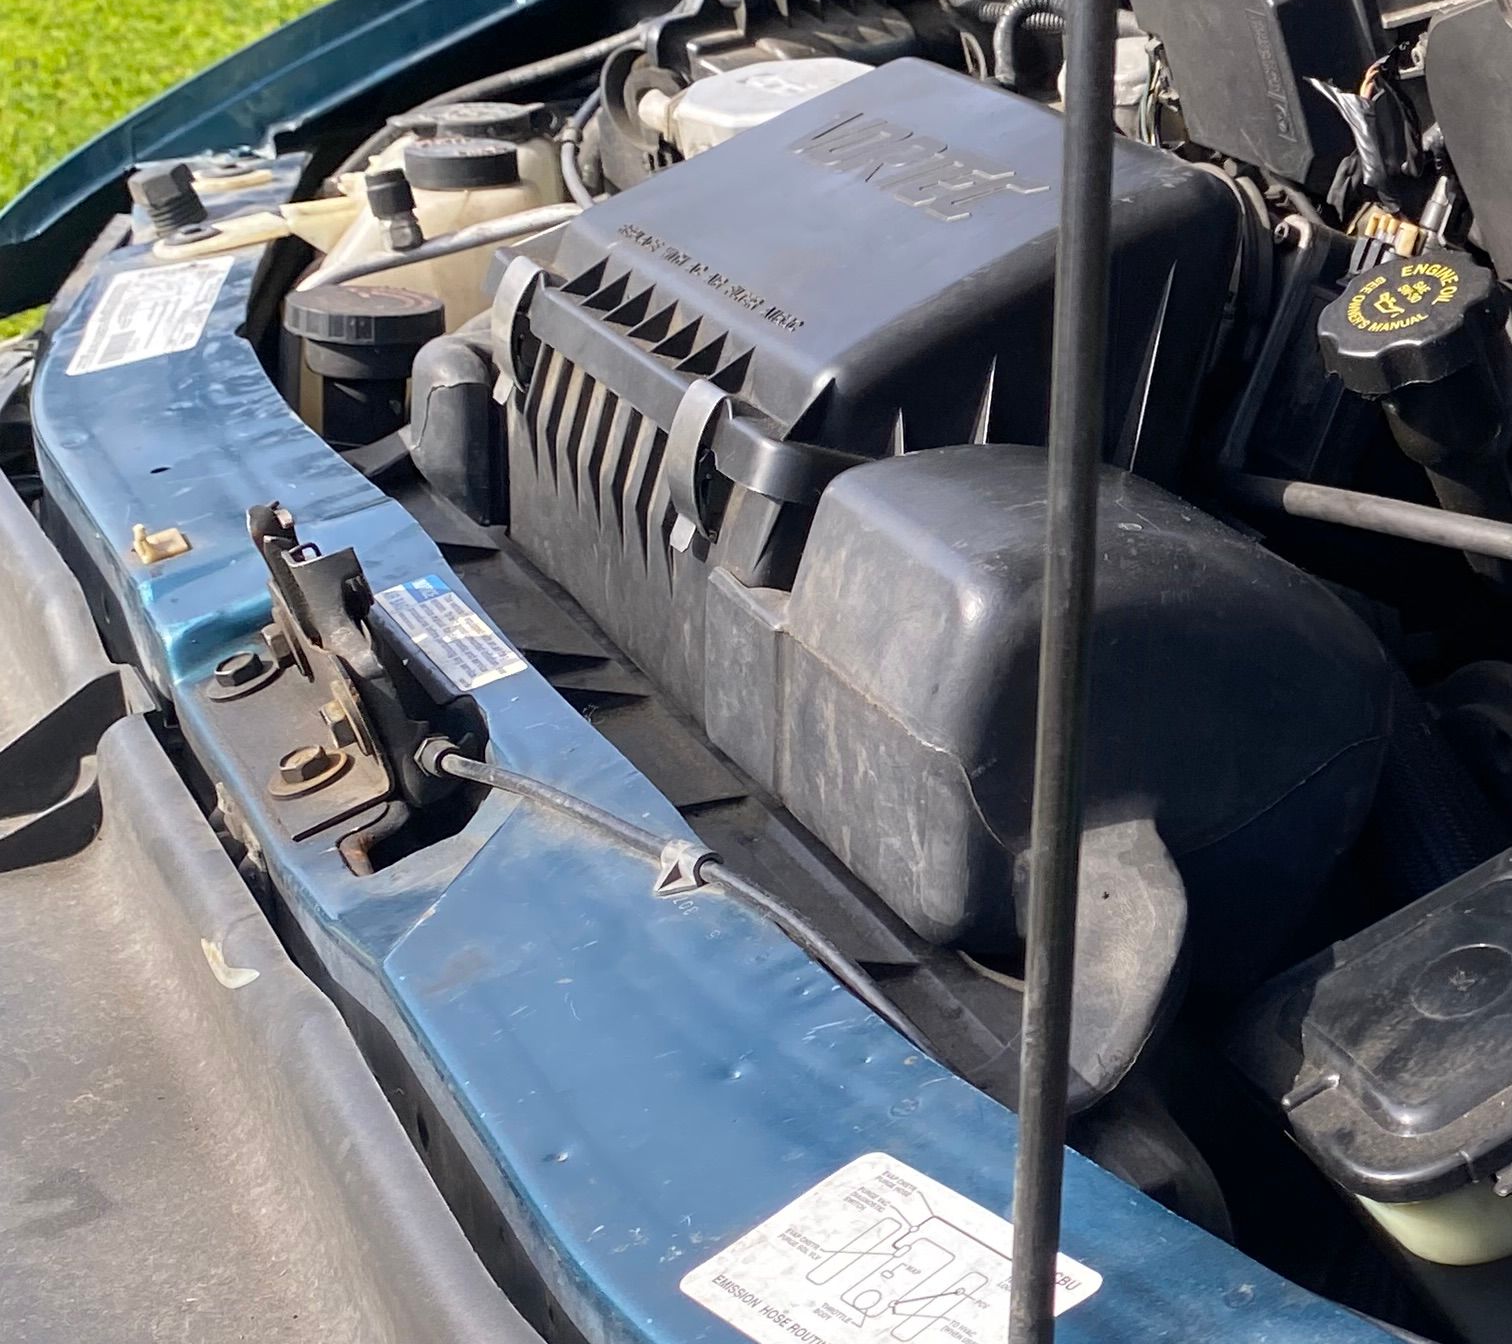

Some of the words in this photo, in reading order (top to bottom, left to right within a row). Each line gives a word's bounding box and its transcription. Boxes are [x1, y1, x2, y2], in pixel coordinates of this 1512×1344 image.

[1401, 264, 1459, 286] ENGINE
[1431, 286, 1458, 305] OIL
[1368, 313, 1429, 332] MANUAL
[712, 1274, 762, 1308] EMISSION
[759, 1305, 792, 1328] HOSE
[821, 1302, 852, 1324] THROTTLE
